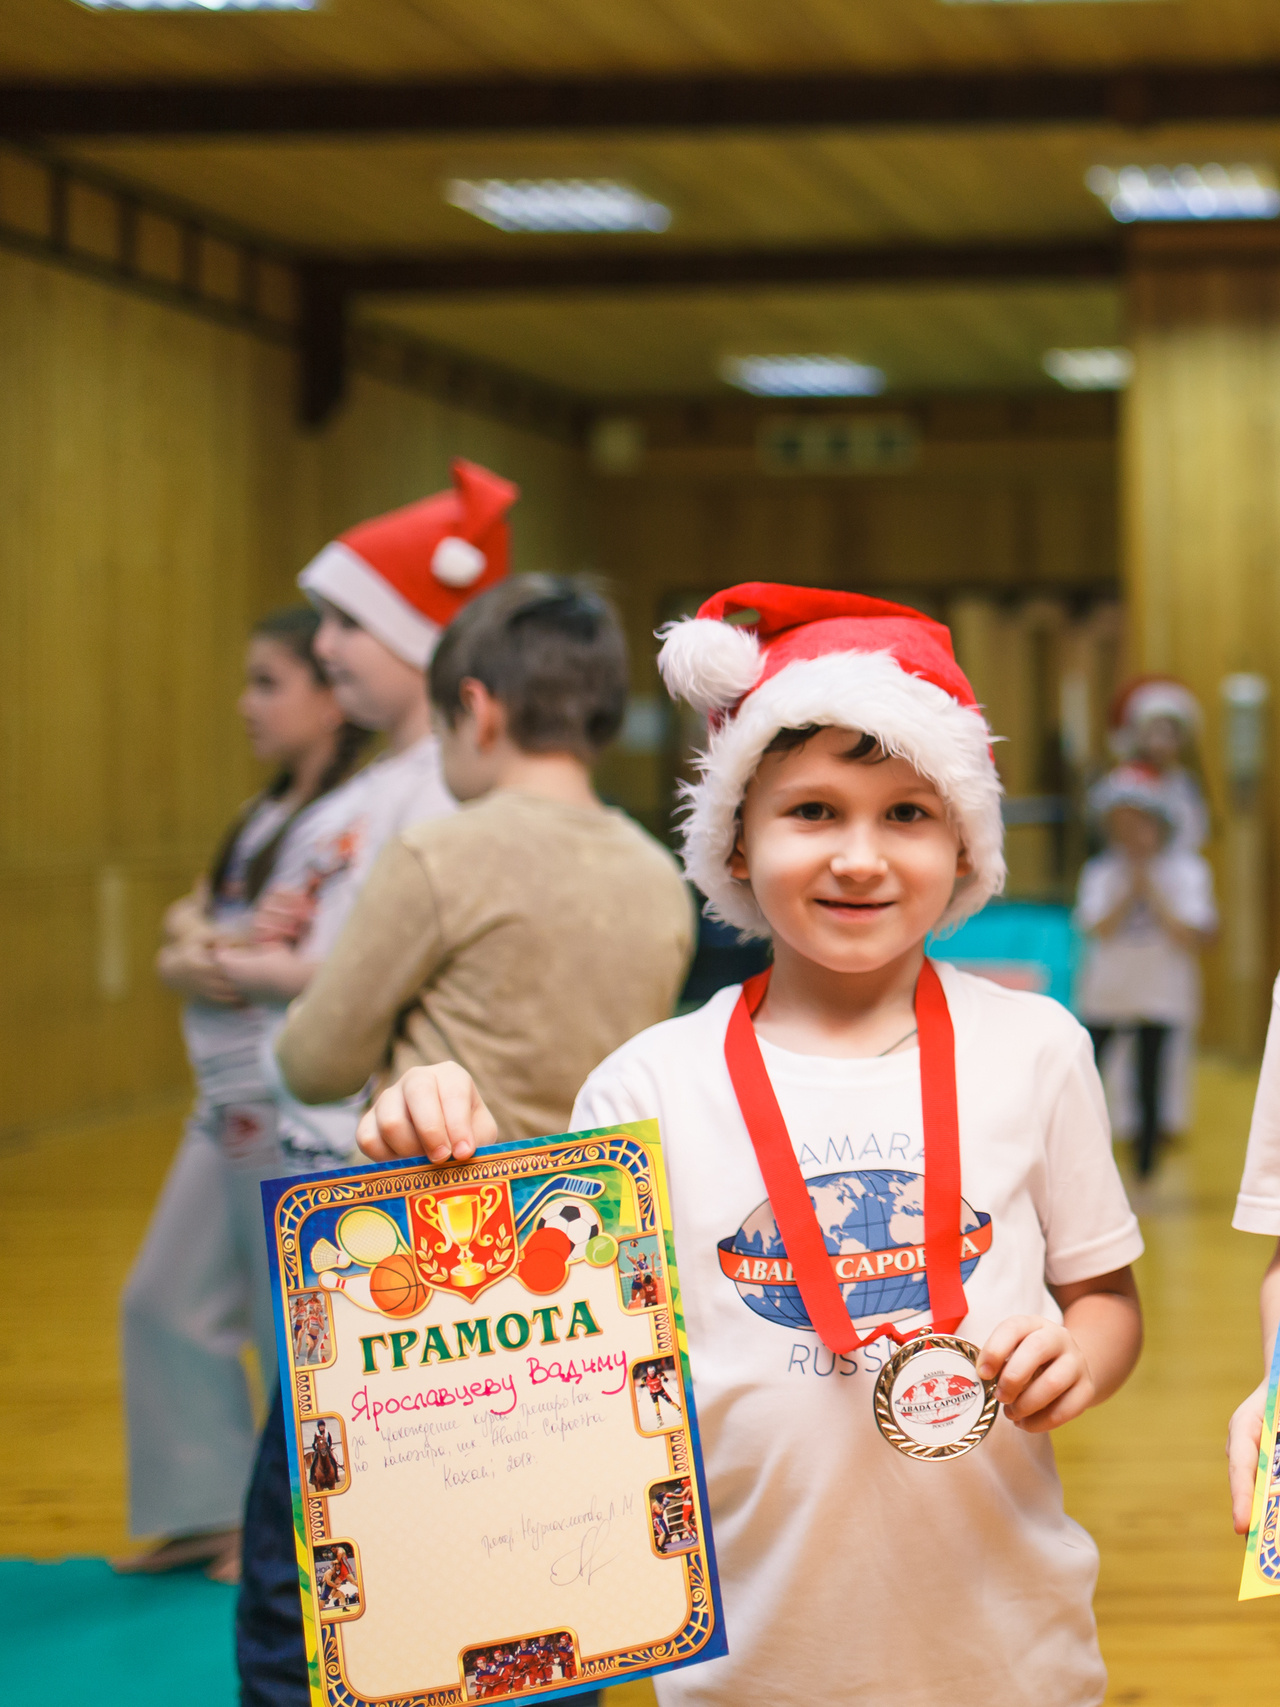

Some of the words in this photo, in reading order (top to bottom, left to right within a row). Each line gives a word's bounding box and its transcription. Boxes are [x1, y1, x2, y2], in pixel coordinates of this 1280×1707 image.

[798, 1131, 925, 1166] AMAR
[835, 1236, 981, 1279] CAPOEA
[358, 1299, 604, 1376] ГРАМОТА
[350, 1374, 518, 1432] Ярославцеву
[525, 1350, 628, 1395] Вадиму
